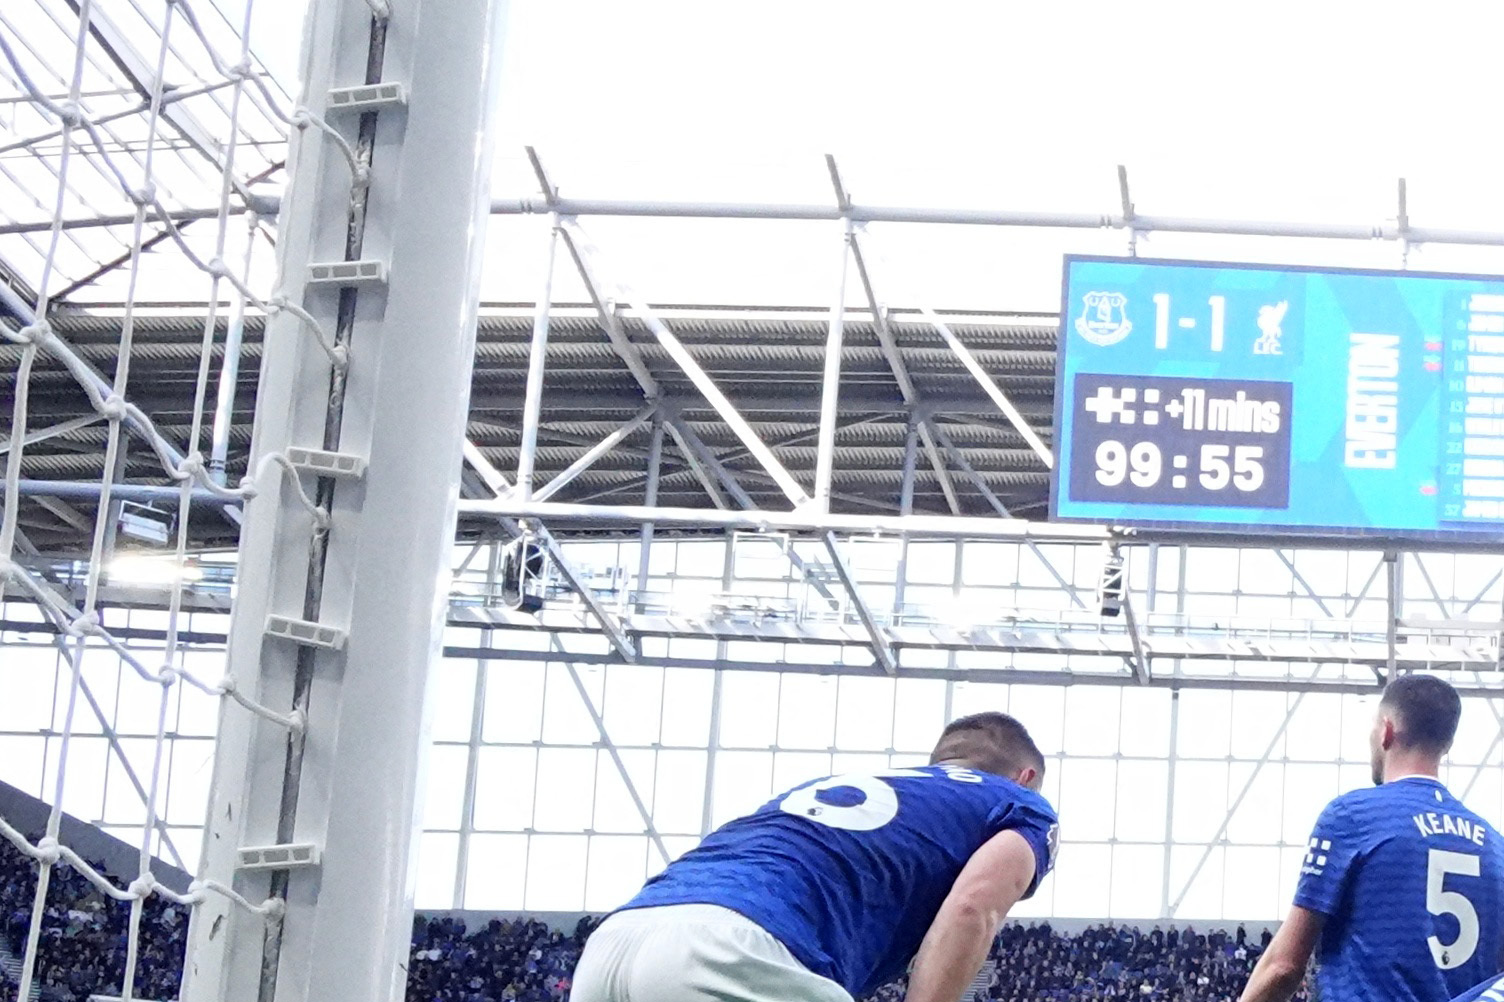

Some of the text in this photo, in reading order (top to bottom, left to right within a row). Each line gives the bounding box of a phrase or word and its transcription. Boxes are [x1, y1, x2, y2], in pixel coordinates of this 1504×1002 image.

[1165, 389, 1280, 433] +11 mins
[1345, 333, 1400, 468] EVERTON
[1095, 440, 1264, 491] 99:55
[1413, 812, 1486, 846] KEANE
[1426, 849, 1480, 970] 5
